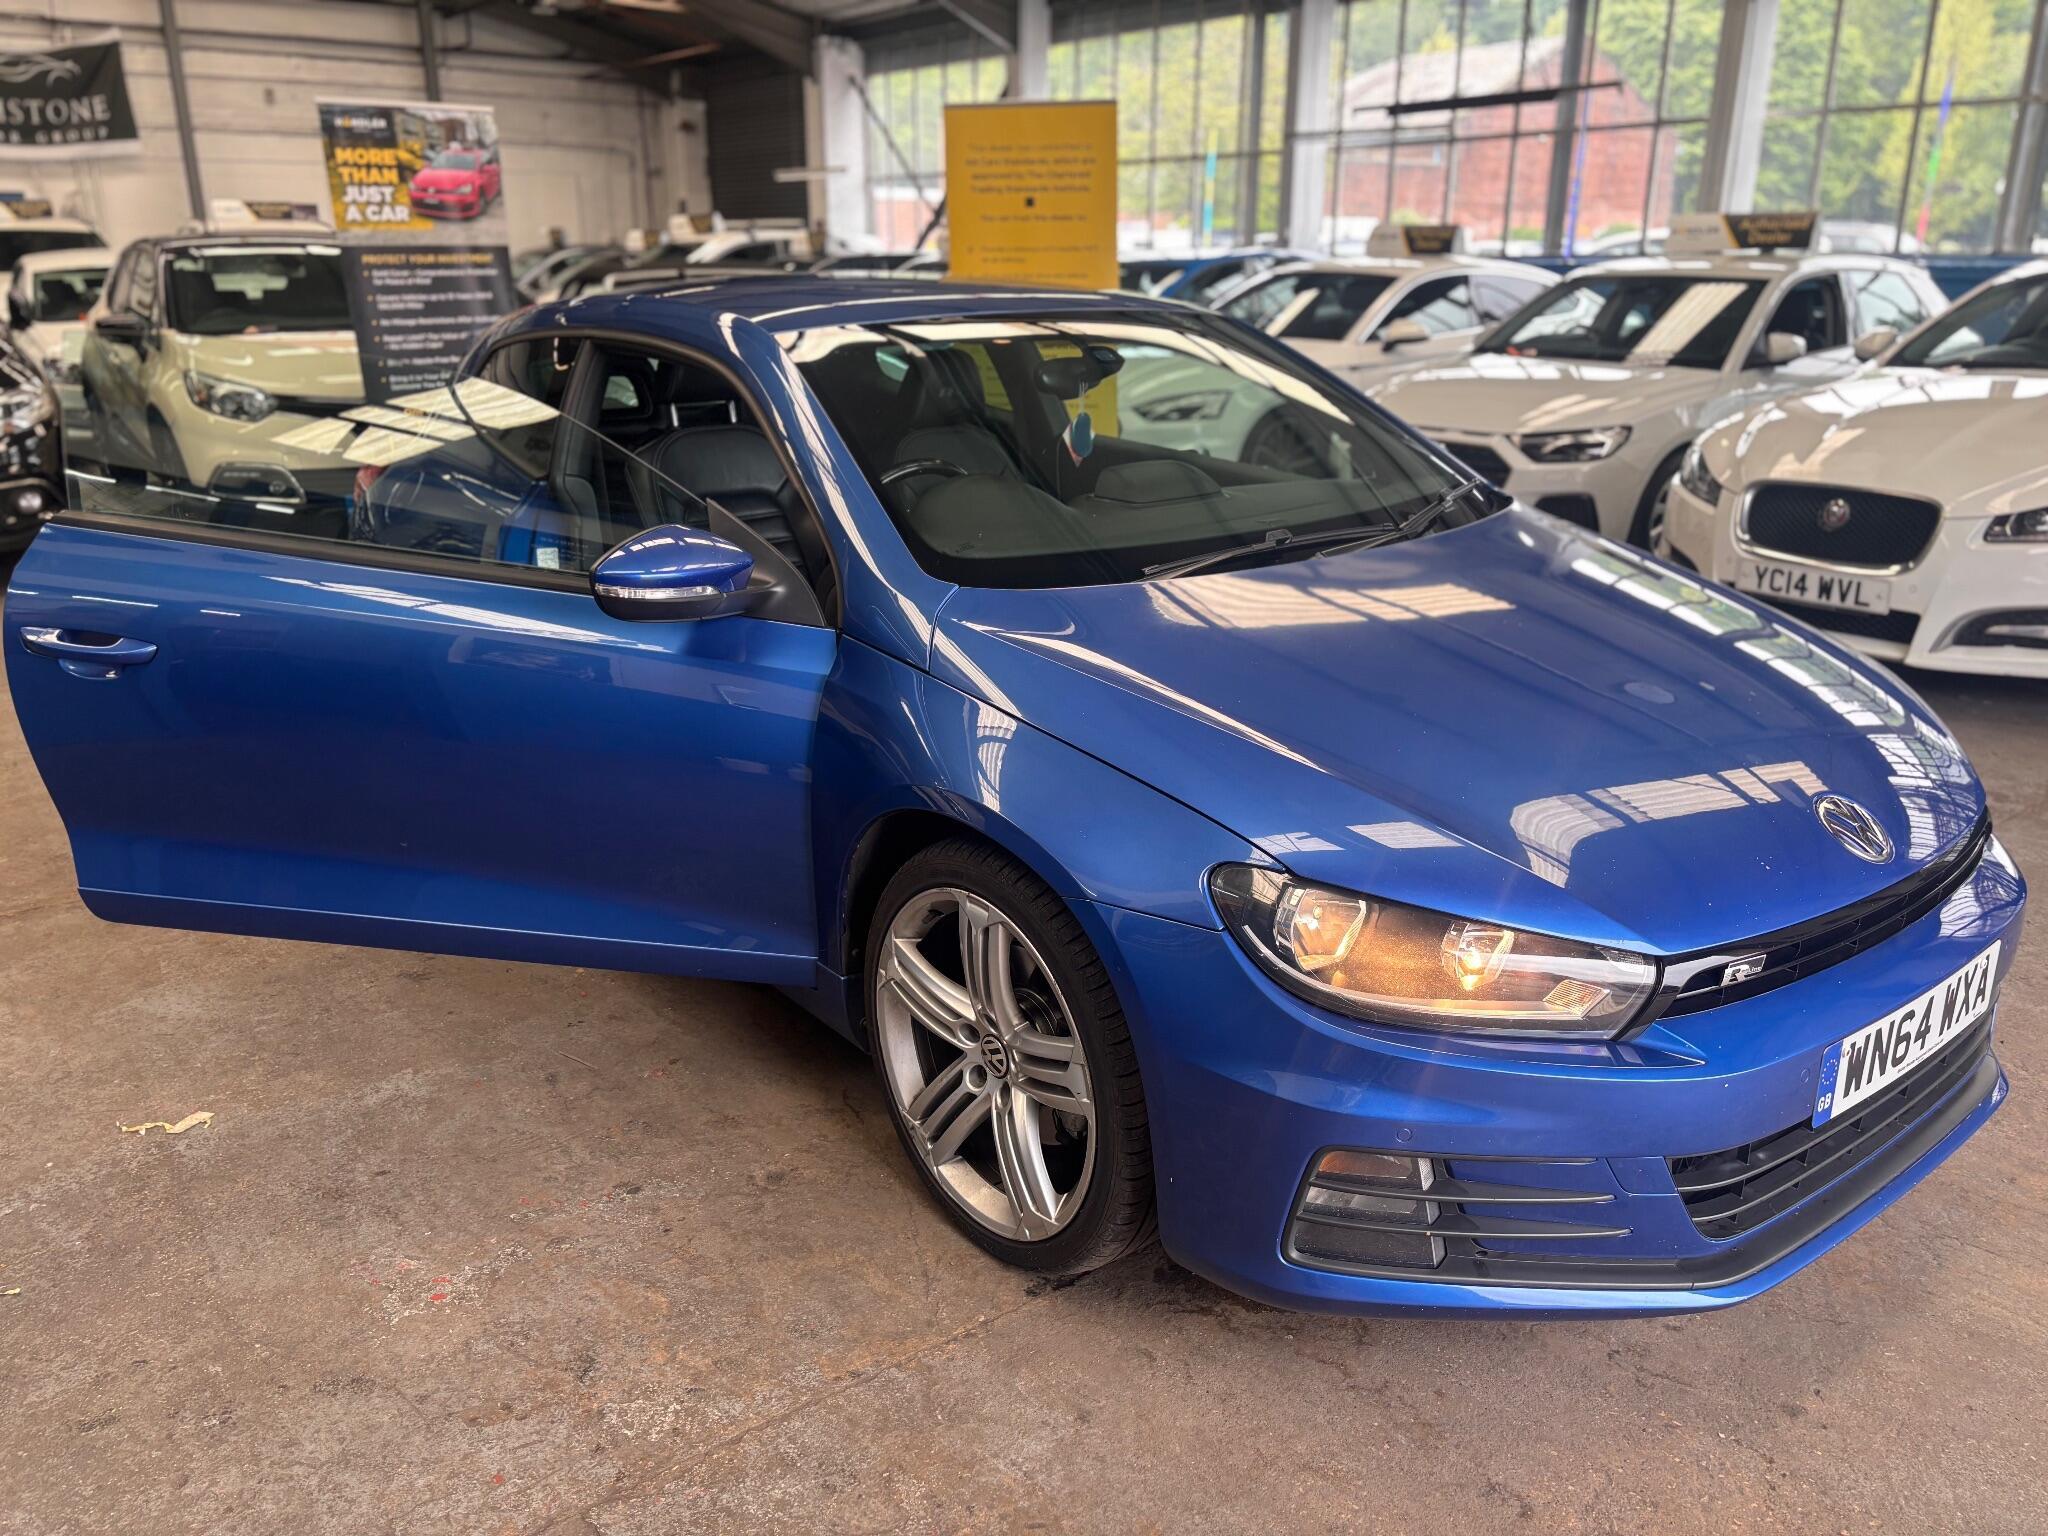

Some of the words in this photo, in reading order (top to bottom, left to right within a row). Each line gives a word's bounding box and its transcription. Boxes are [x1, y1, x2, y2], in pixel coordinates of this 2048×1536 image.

[0, 93, 111, 126] STONE
[334, 147, 398, 165] MORE
[338, 166, 399, 184] THAN
[343, 185, 395, 203] JUST
[346, 205, 362, 223] A
[365, 205, 410, 222] CAR
[1756, 565, 1808, 596] YC14
[1818, 575, 1870, 607] WVL
[1842, 995, 1935, 1099] WN64
[1938, 954, 1991, 1037] WXA
[1817, 1092, 1832, 1112] GB
